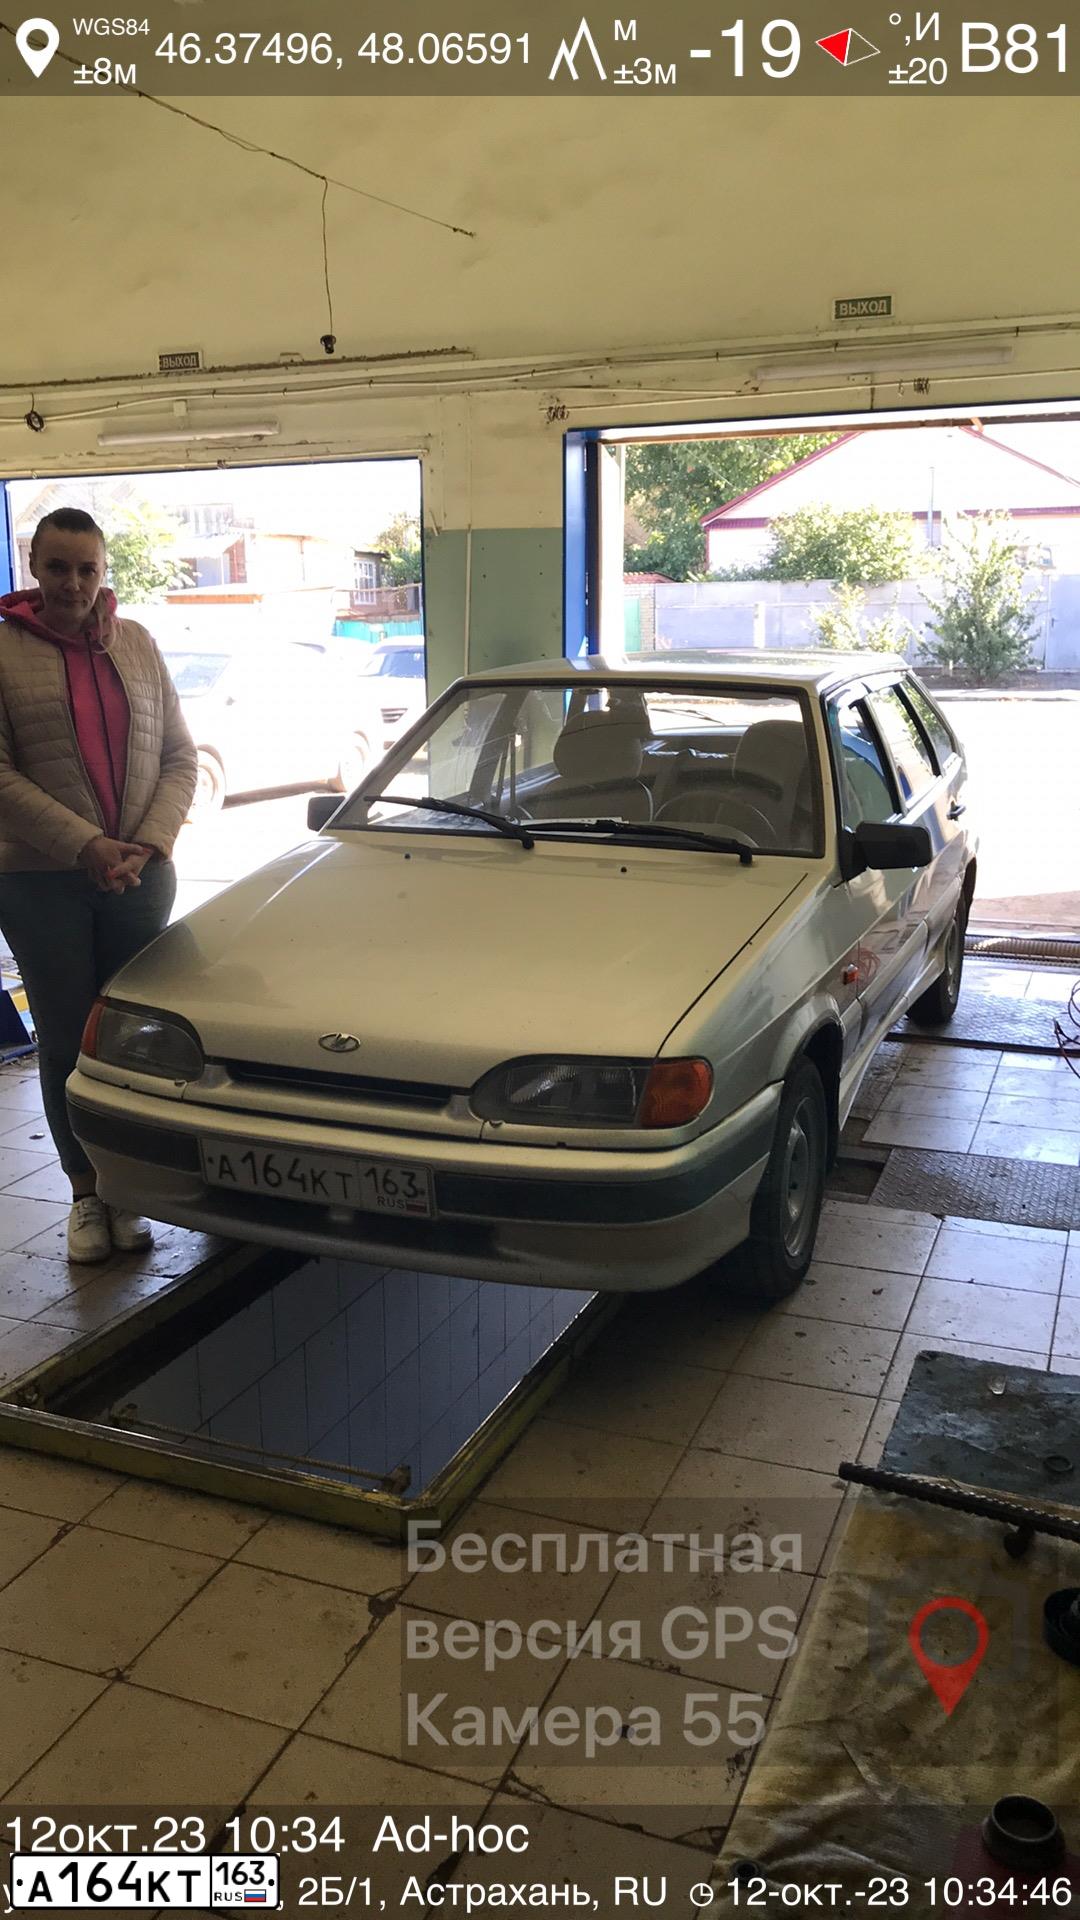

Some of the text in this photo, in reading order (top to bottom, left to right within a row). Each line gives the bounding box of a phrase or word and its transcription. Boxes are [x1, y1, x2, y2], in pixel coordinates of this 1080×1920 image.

[839, 299, 888, 316] ВЫХОД
[162, 355, 197, 369] ВЫХОД
[364, 1167, 419, 1198] 163
[376, 1195, 406, 1210] RUS
